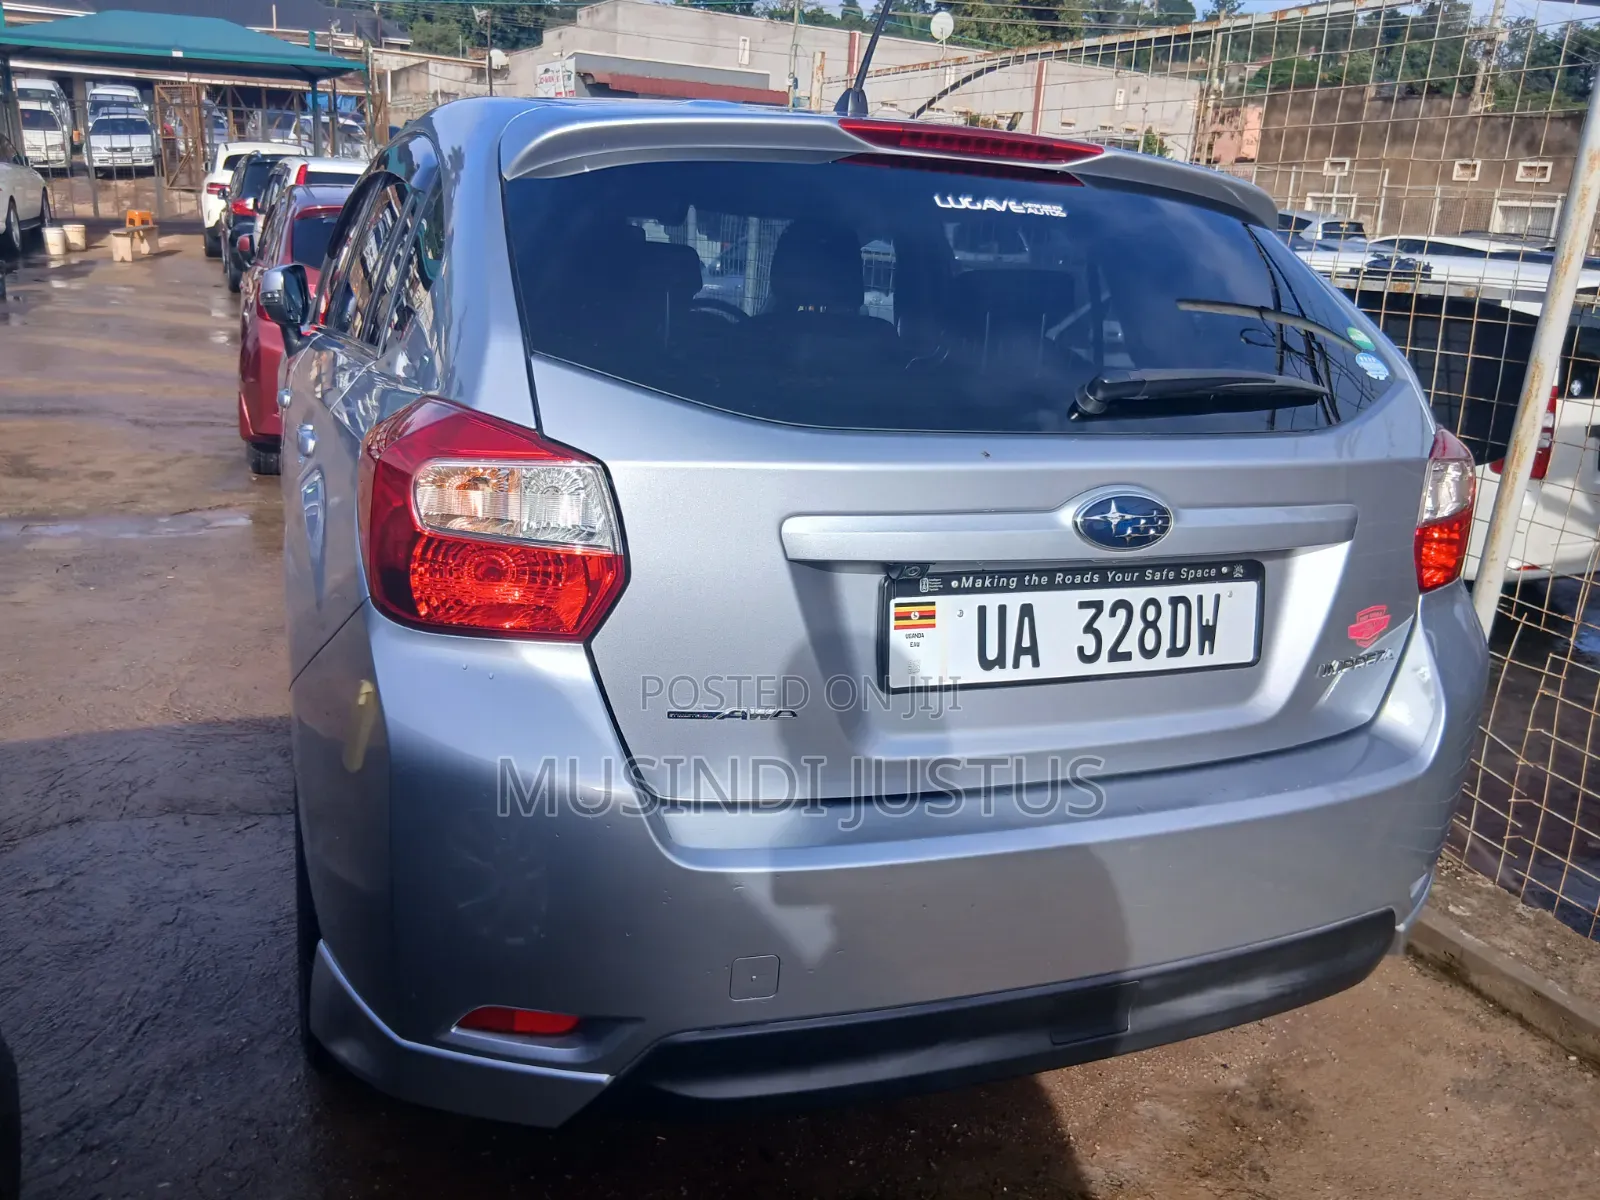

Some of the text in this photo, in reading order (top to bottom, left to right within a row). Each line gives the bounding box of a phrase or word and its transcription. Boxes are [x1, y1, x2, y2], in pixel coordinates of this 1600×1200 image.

[961, 567, 1216, 589] Making the Roads Your Safe Space
[976, 593, 1221, 671] UA 328DW
